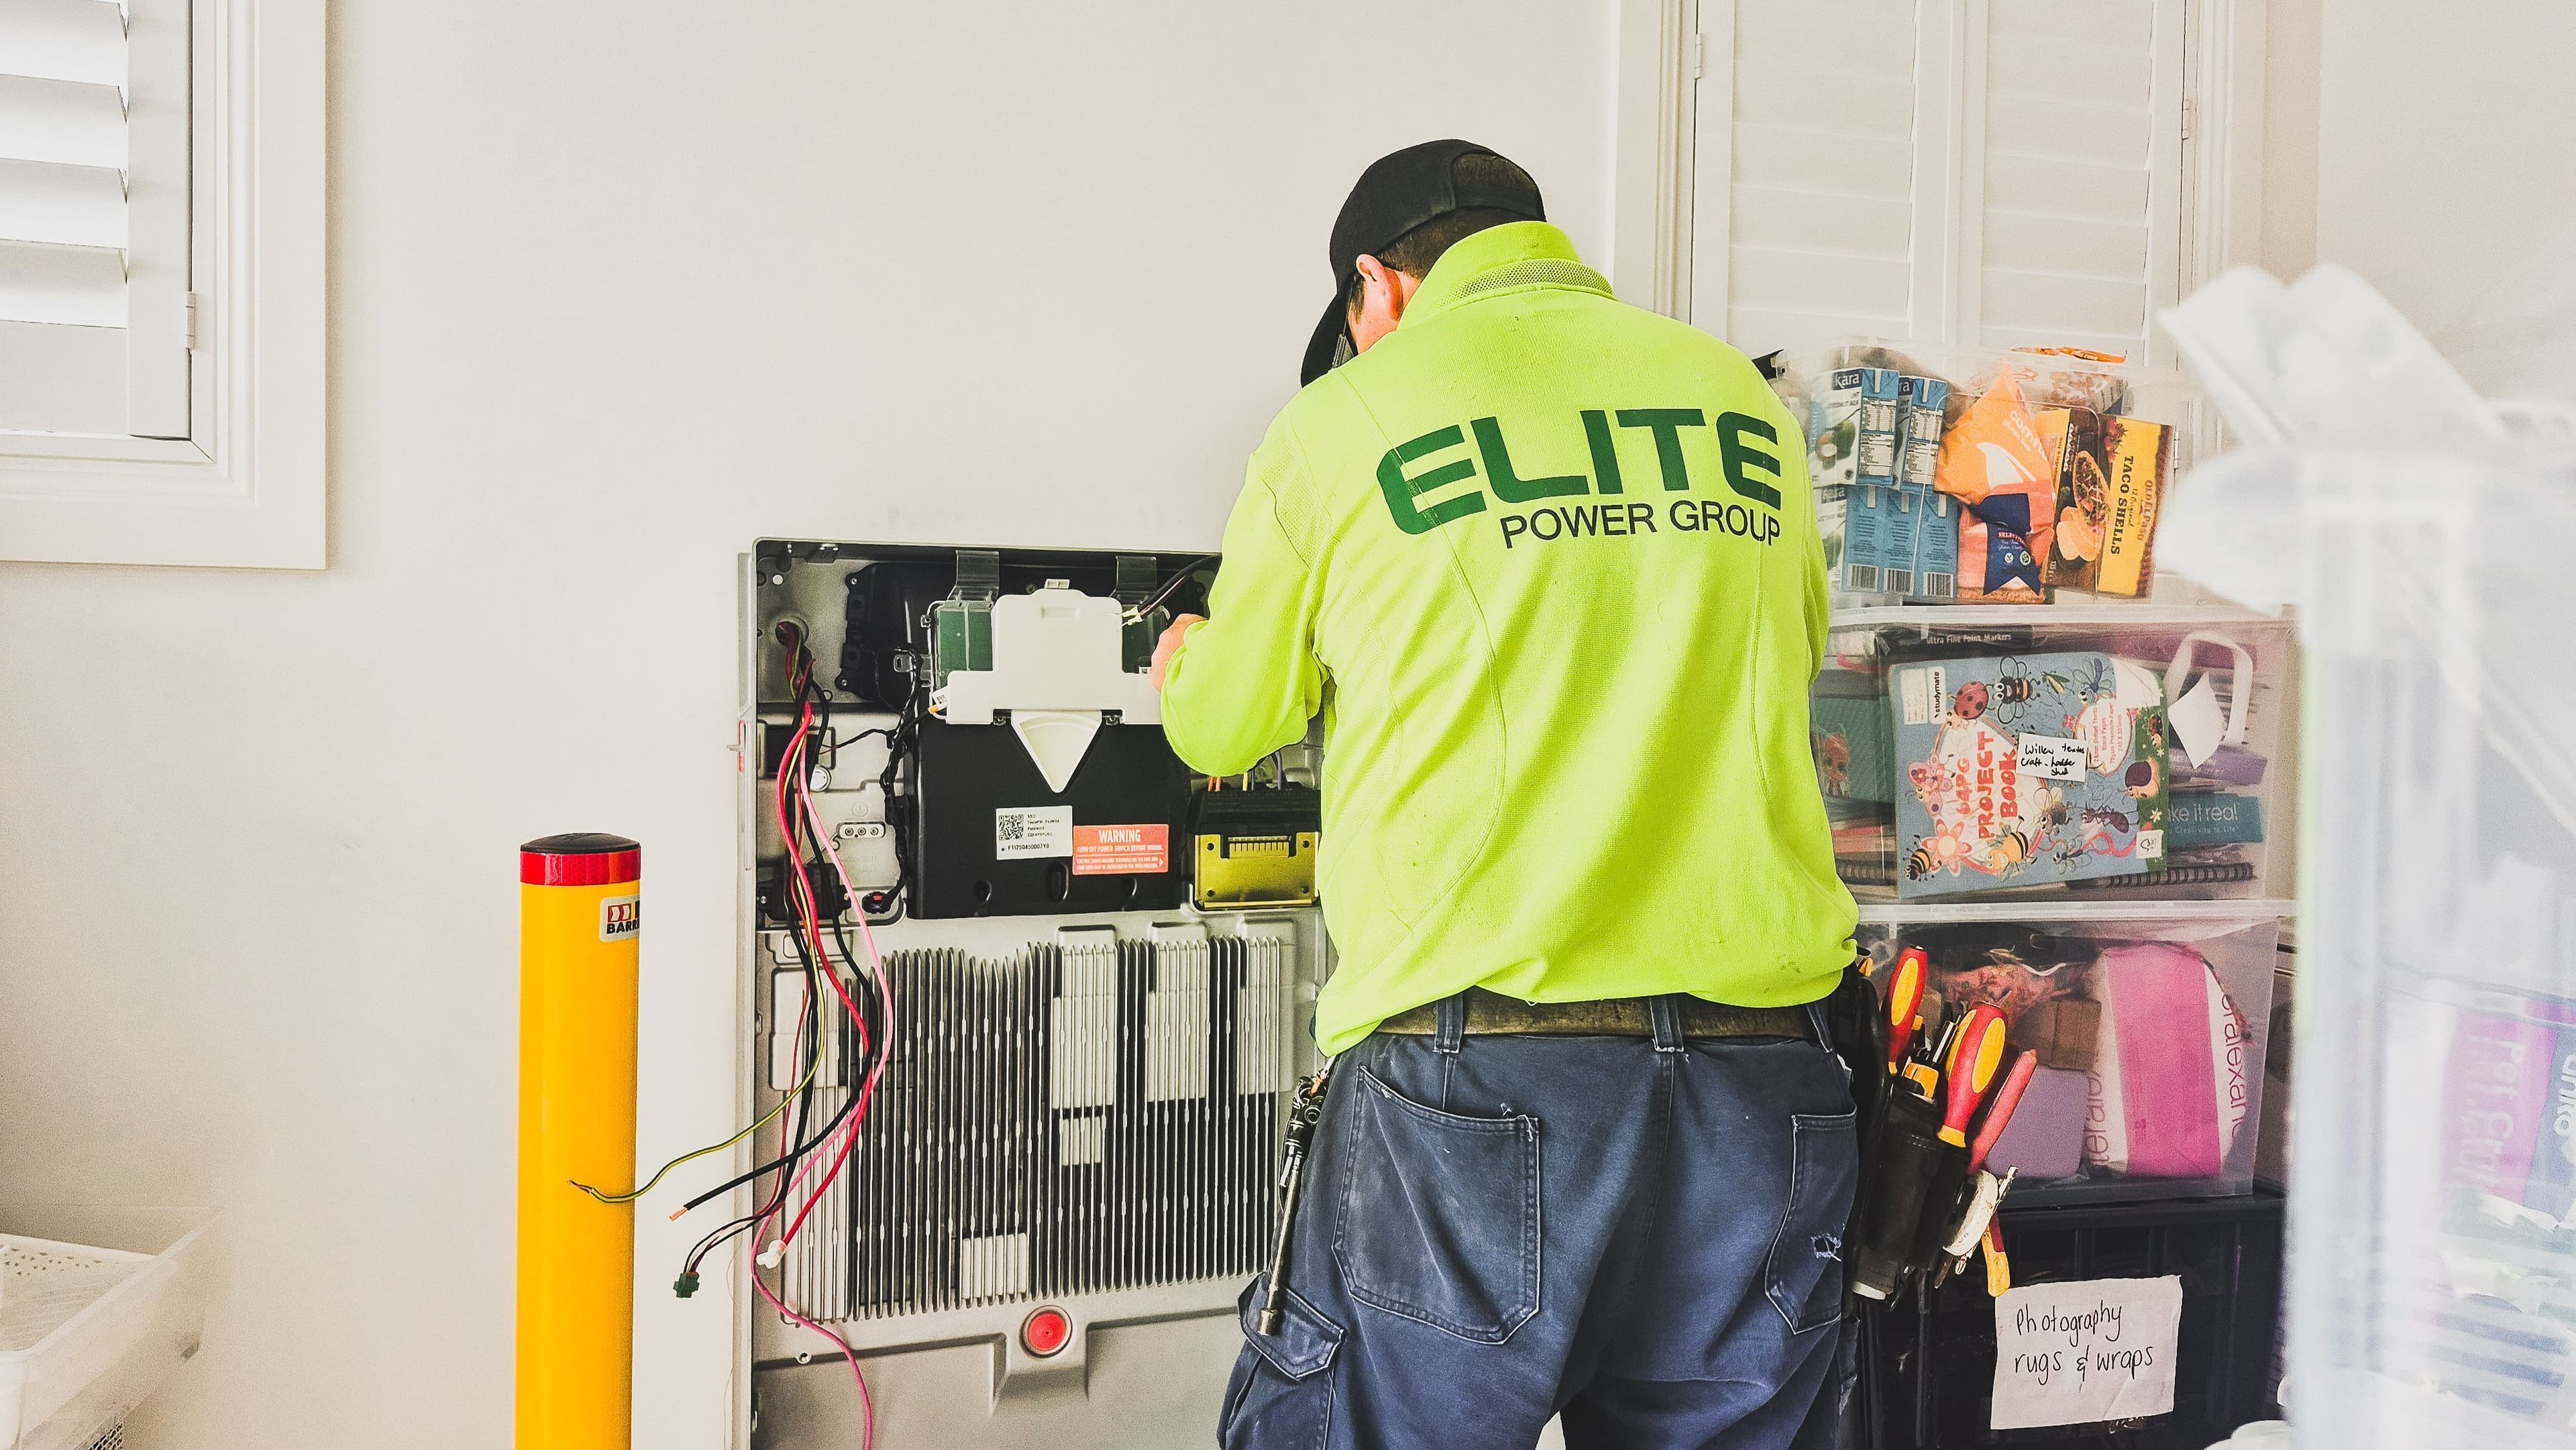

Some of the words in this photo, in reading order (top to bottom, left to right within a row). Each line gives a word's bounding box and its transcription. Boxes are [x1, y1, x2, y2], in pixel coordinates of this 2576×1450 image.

[1835, 373, 1860, 388] kara
[1900, 382, 1910, 392] ra
[1377, 408, 1782, 535] ELITE
[2120, 456, 2134, 494] TACO
[1500, 502, 1657, 548] POWER
[1670, 500, 1781, 546] GROUP
[2110, 498, 2127, 555] SHELLS
[1946, 636, 1961, 644] Fine
[1963, 634, 1982, 643] Point
[1984, 633, 2011, 642] Markers
[1955, 758, 1973, 815] 64PG
[1977, 731, 1995, 840] PROJECT
[1998, 748, 2018, 818] BOOK
[2194, 803, 2202, 822] it
[1099, 829, 1141, 843] WARNING
[2016, 1299, 2122, 1347] Photography
[2014, 1350, 2062, 1386] rugs
[2076, 1345, 2090, 1382] &
[2097, 1345, 2153, 1380] wraps
